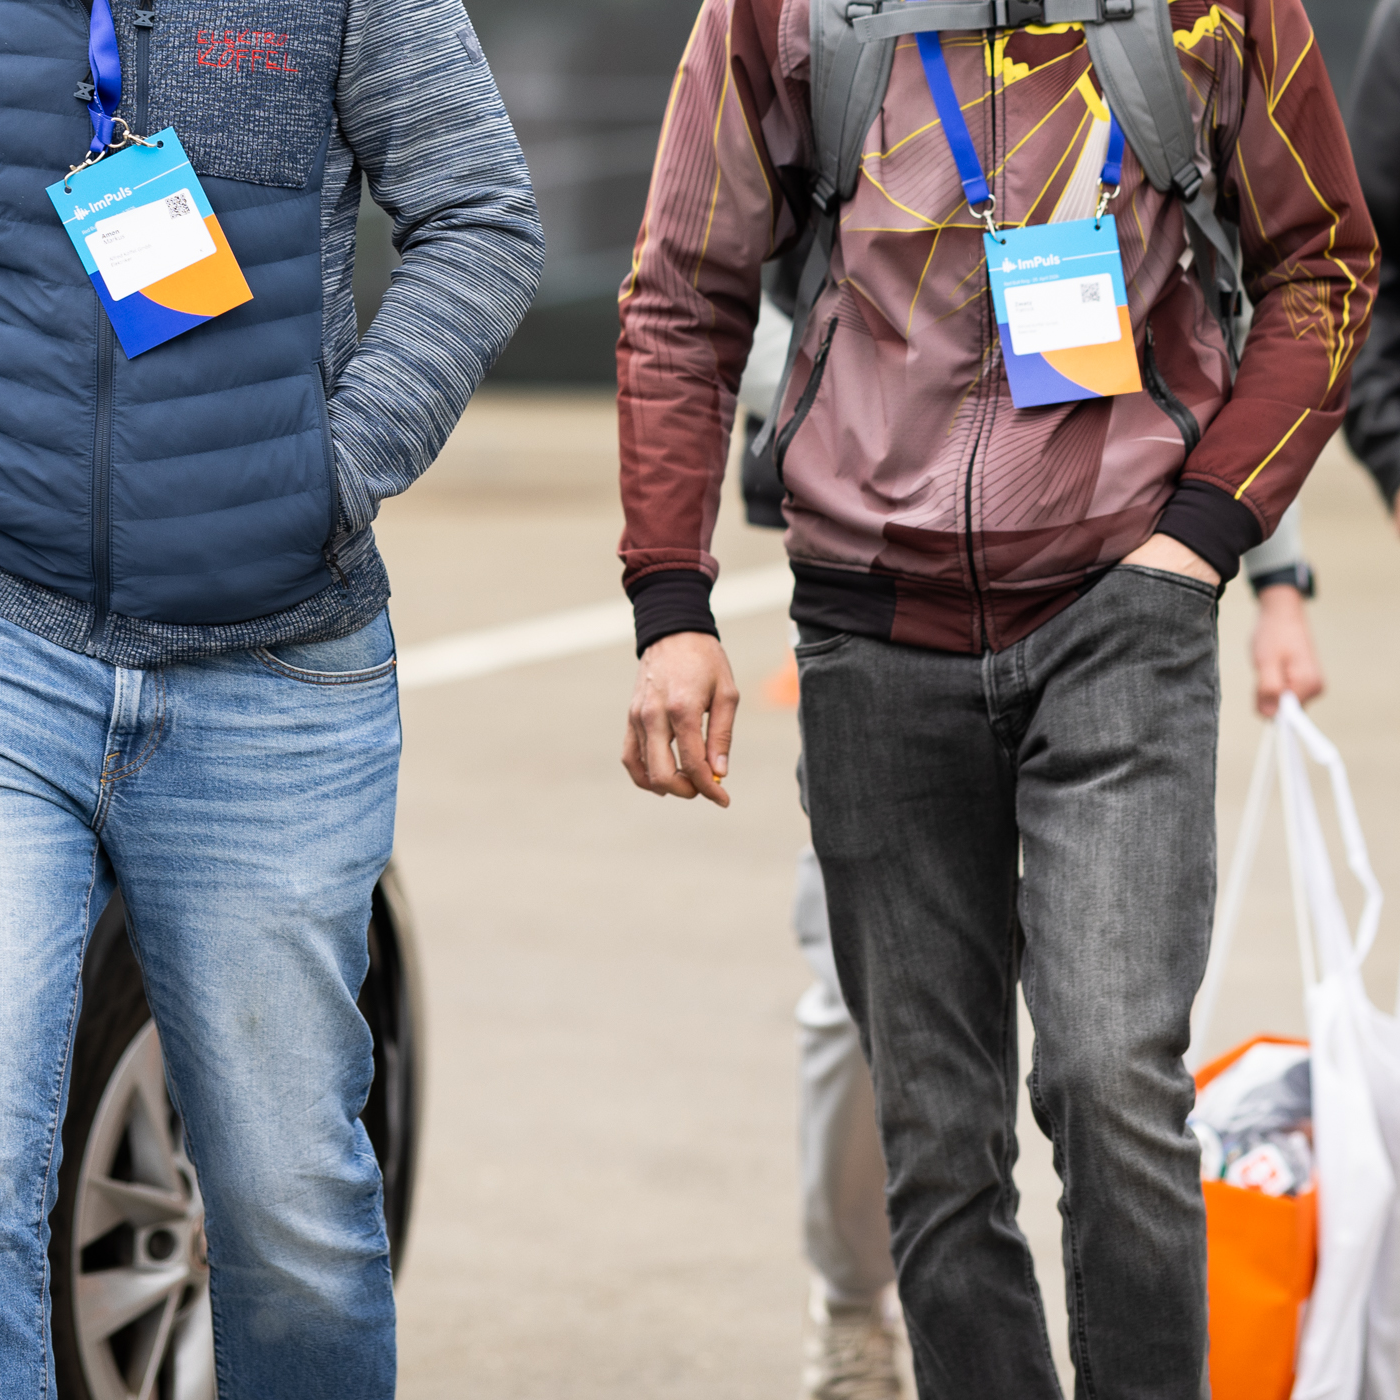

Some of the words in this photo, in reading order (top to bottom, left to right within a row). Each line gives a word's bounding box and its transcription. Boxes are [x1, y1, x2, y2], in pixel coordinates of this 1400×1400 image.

[197, 29, 288, 47] ELEKTRO
[197, 45, 299, 72] KÖFFEL
[88, 187, 133, 213] ImPuls
[1017, 254, 1061, 270] ImPuls
